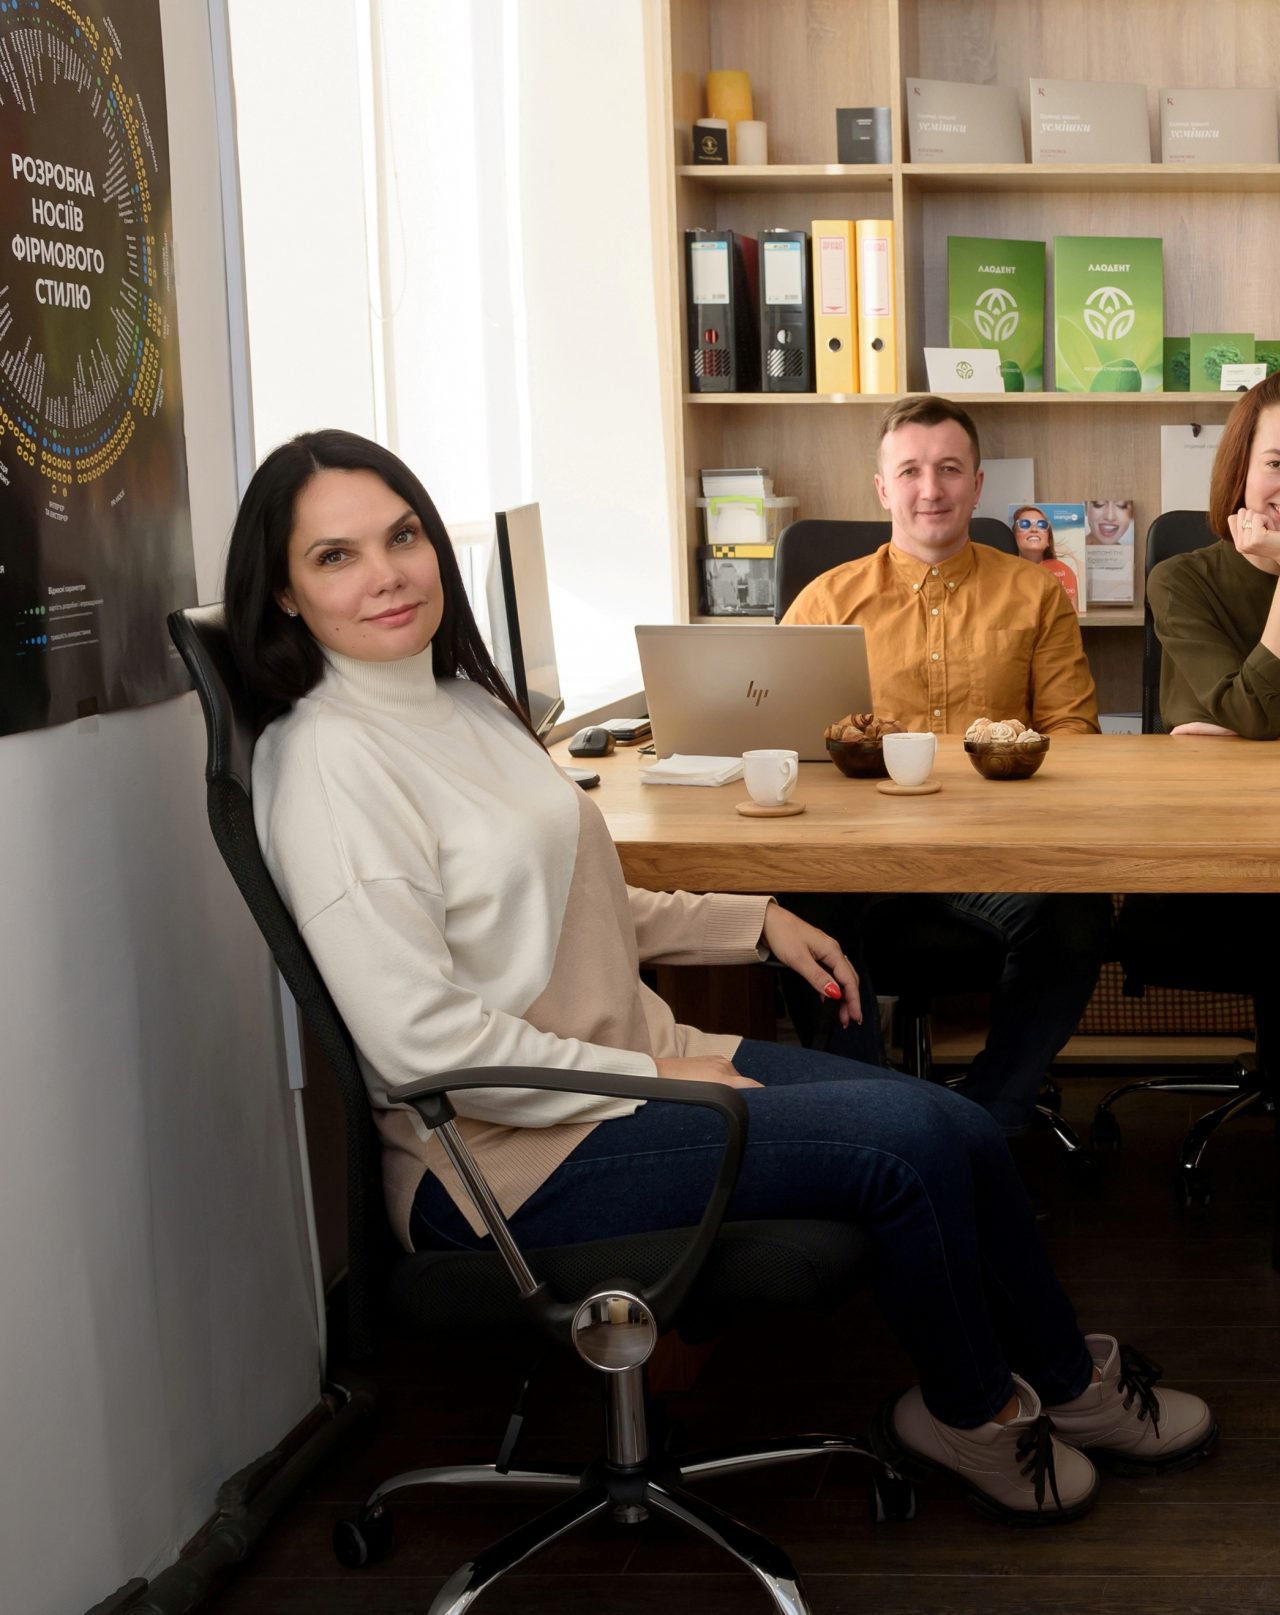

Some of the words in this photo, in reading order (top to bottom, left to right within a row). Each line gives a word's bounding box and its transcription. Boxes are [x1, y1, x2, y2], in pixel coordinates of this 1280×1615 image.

[11, 153, 96, 198] РОЗРОБКА
[31, 197, 84, 232] НОСІЇВ
[11, 234, 105, 274] ФІРМОВОГО
[35, 278, 91, 310] СТИЛЮ
[746, 680, 769, 707] hp
